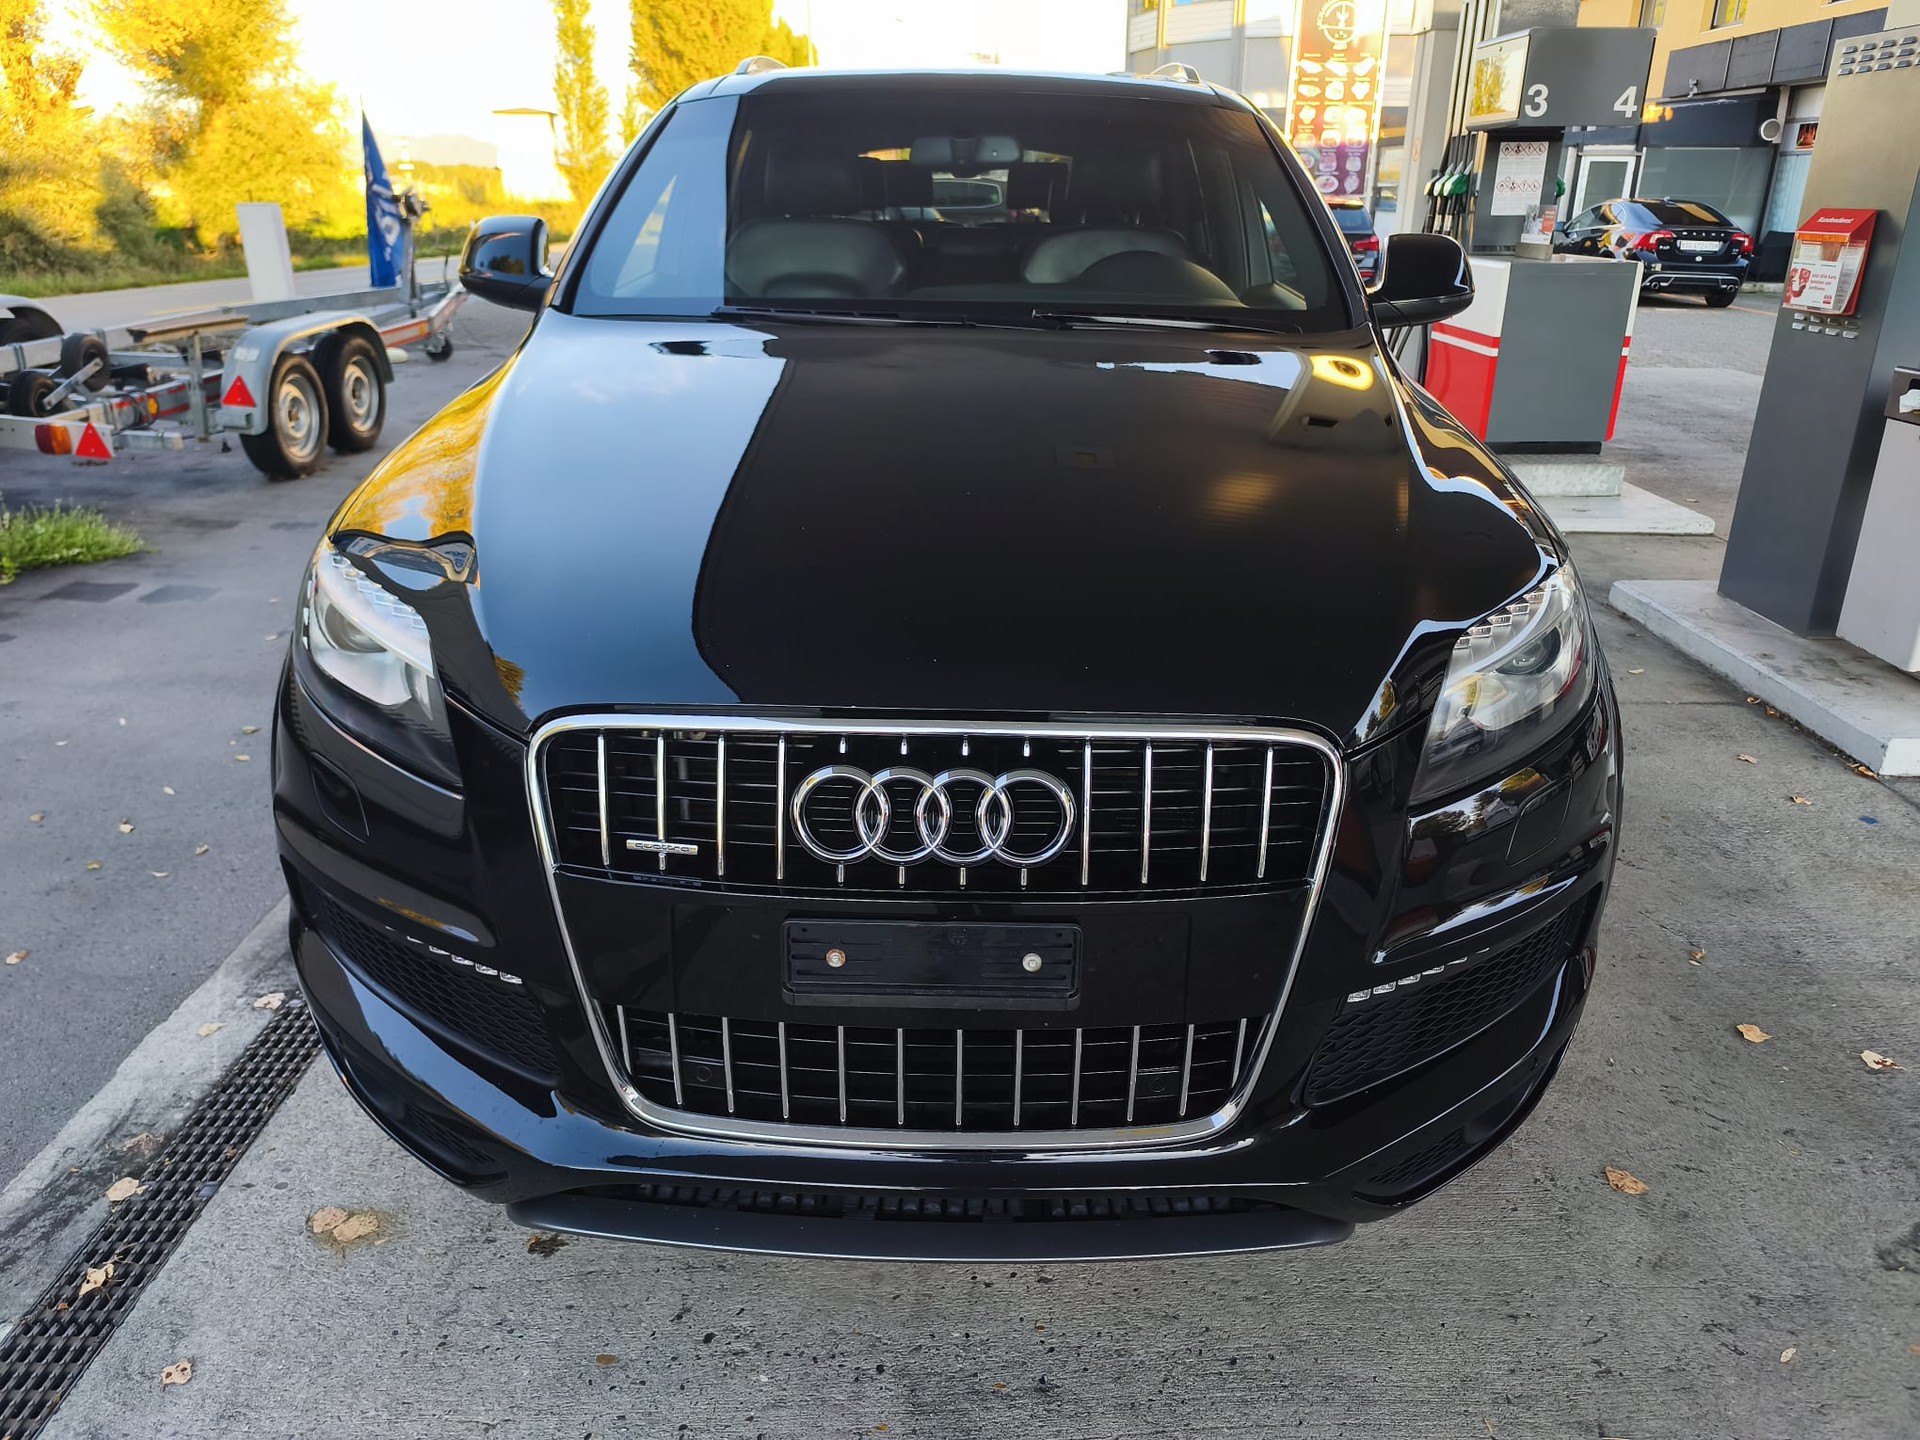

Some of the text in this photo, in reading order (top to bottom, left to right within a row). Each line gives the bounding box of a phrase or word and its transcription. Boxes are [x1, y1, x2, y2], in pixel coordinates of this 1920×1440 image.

[1524, 83, 1549, 118] 3
[1613, 85, 1638, 118] 4
[634, 842, 690, 852] quattro
